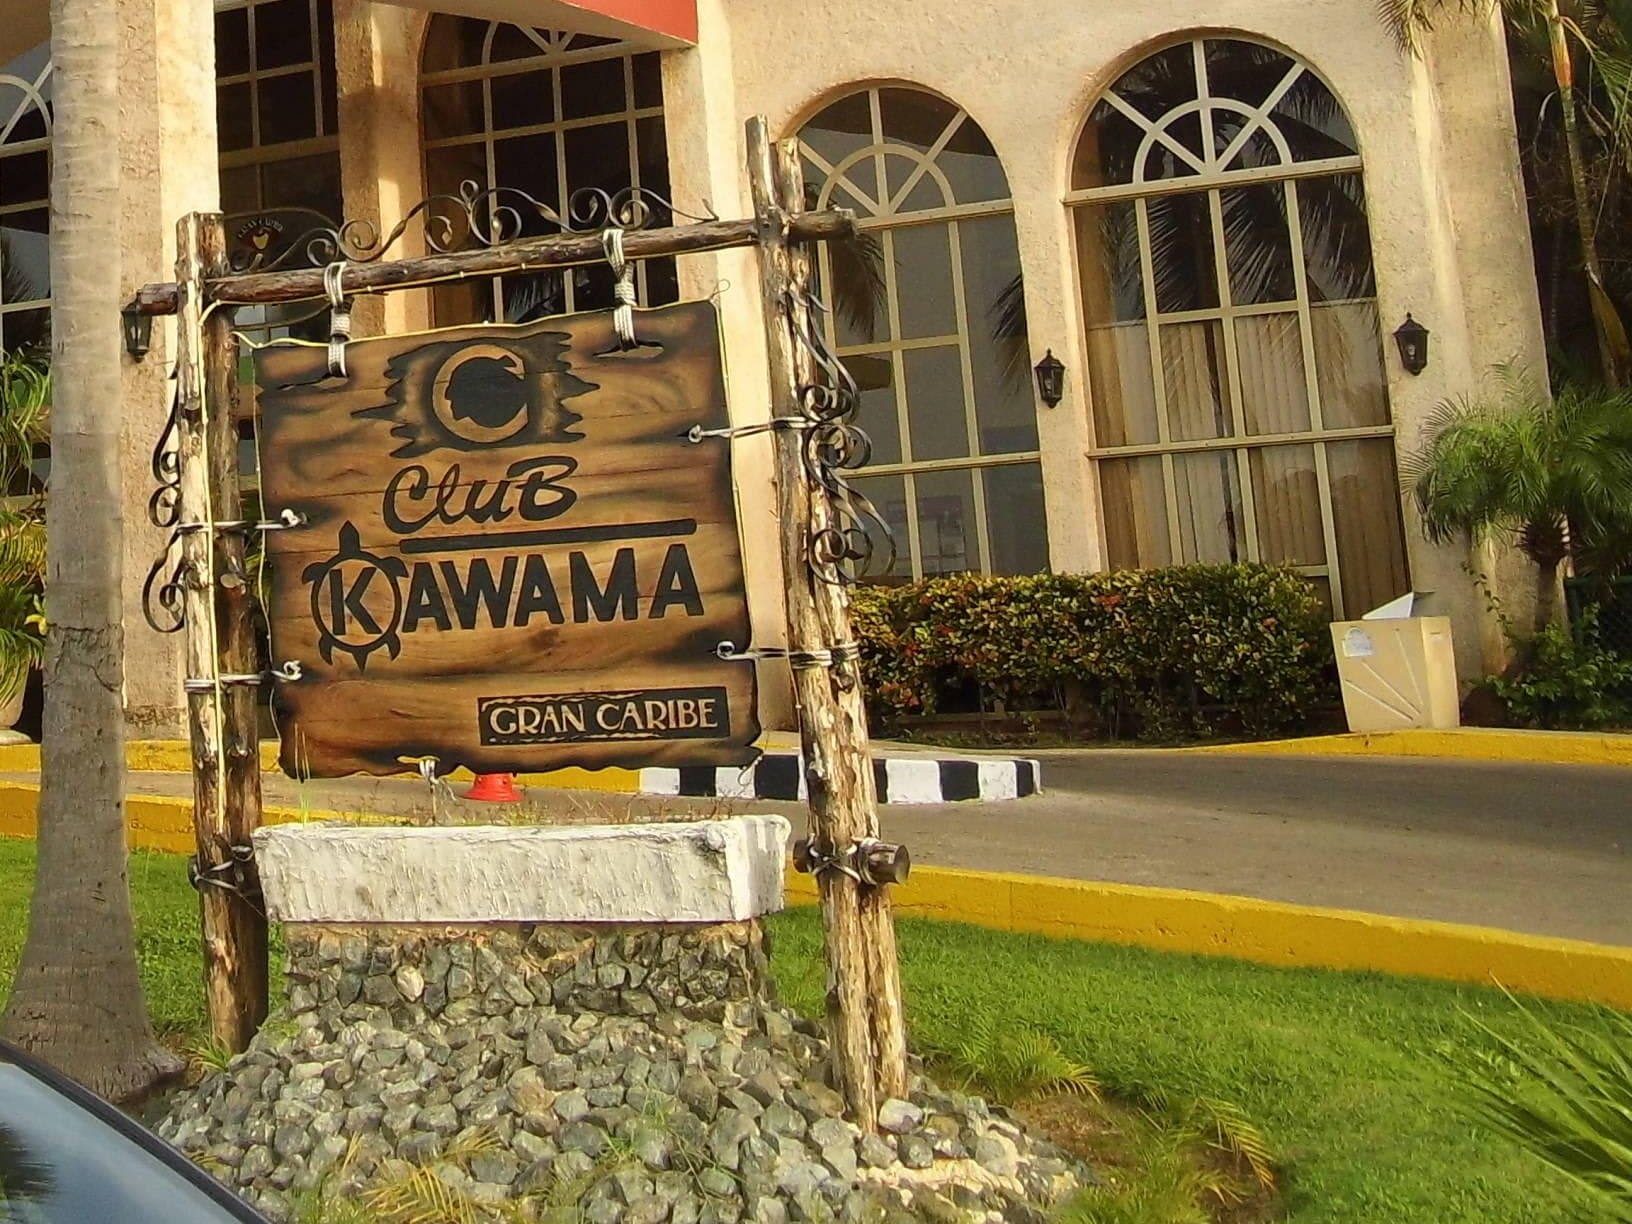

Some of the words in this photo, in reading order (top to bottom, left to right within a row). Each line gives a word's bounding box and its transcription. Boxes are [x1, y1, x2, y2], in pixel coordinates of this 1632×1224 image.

[330, 543, 705, 636] KAWAMA
[489, 703, 586, 735] GRAN
[596, 698, 719, 731] CARIBE
